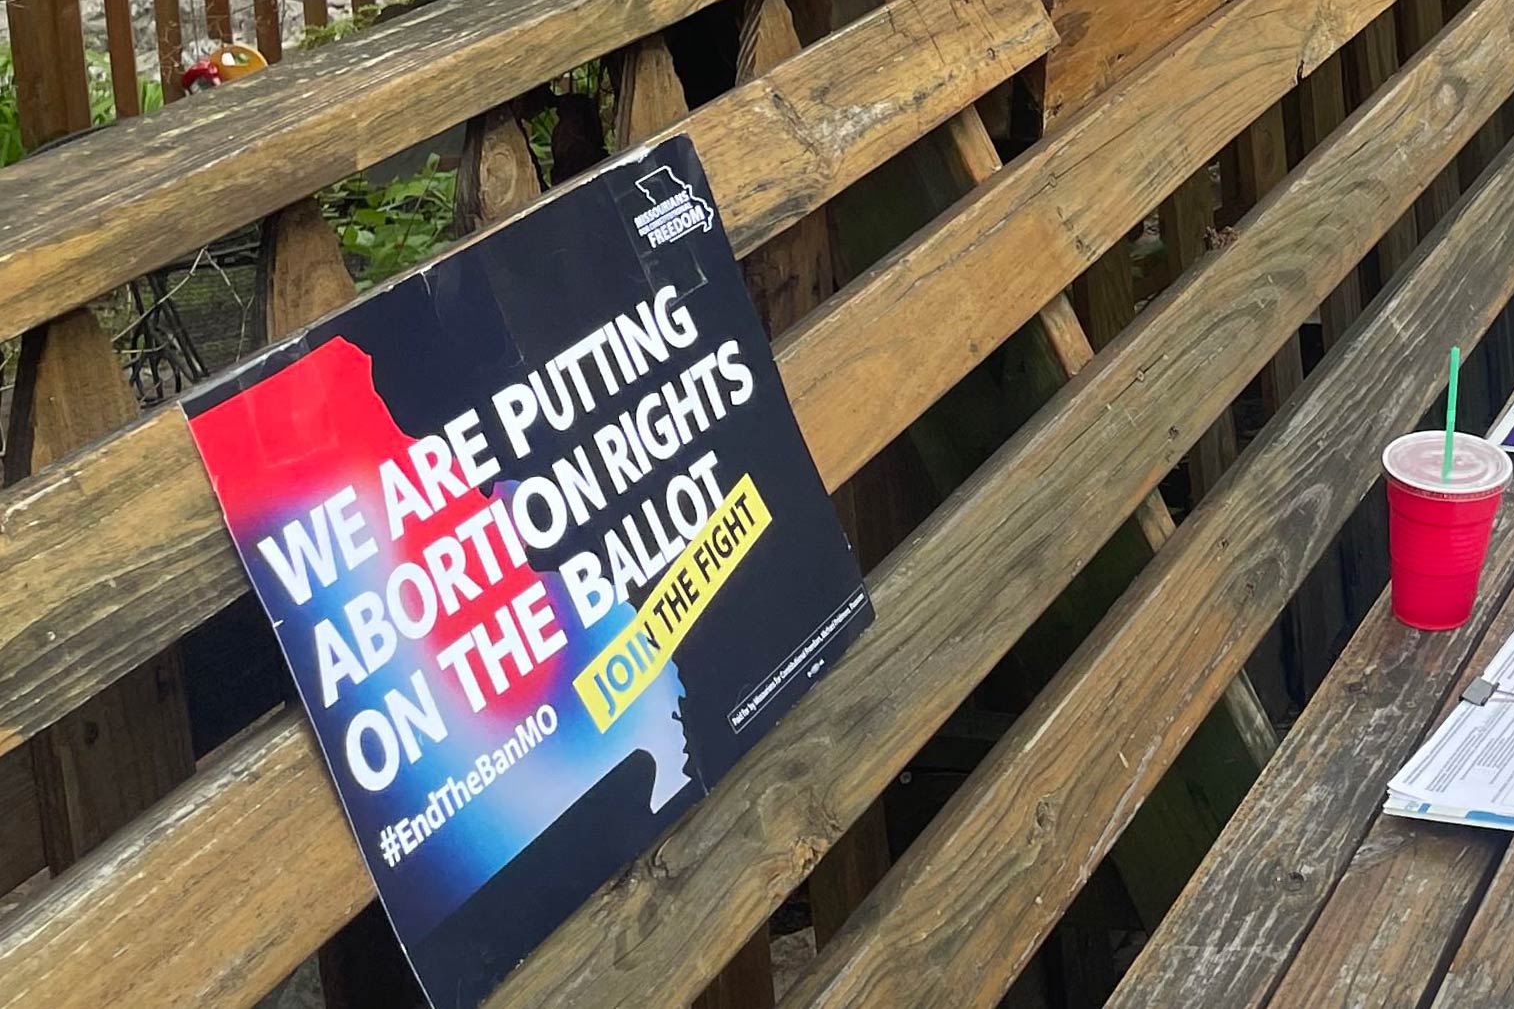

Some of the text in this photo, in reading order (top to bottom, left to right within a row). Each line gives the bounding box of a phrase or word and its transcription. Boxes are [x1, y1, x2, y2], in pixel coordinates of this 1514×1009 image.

[647, 204, 705, 248] FREEDOM
[257, 285, 698, 605] WE ARE PUTTING
[313, 340, 753, 708] ABORTION RIGHTS
[345, 450, 725, 791] ON THE BALLOT
[593, 493, 756, 717] JOIN THE FIGHT
[378, 704, 558, 867] #EndTheBanMO
